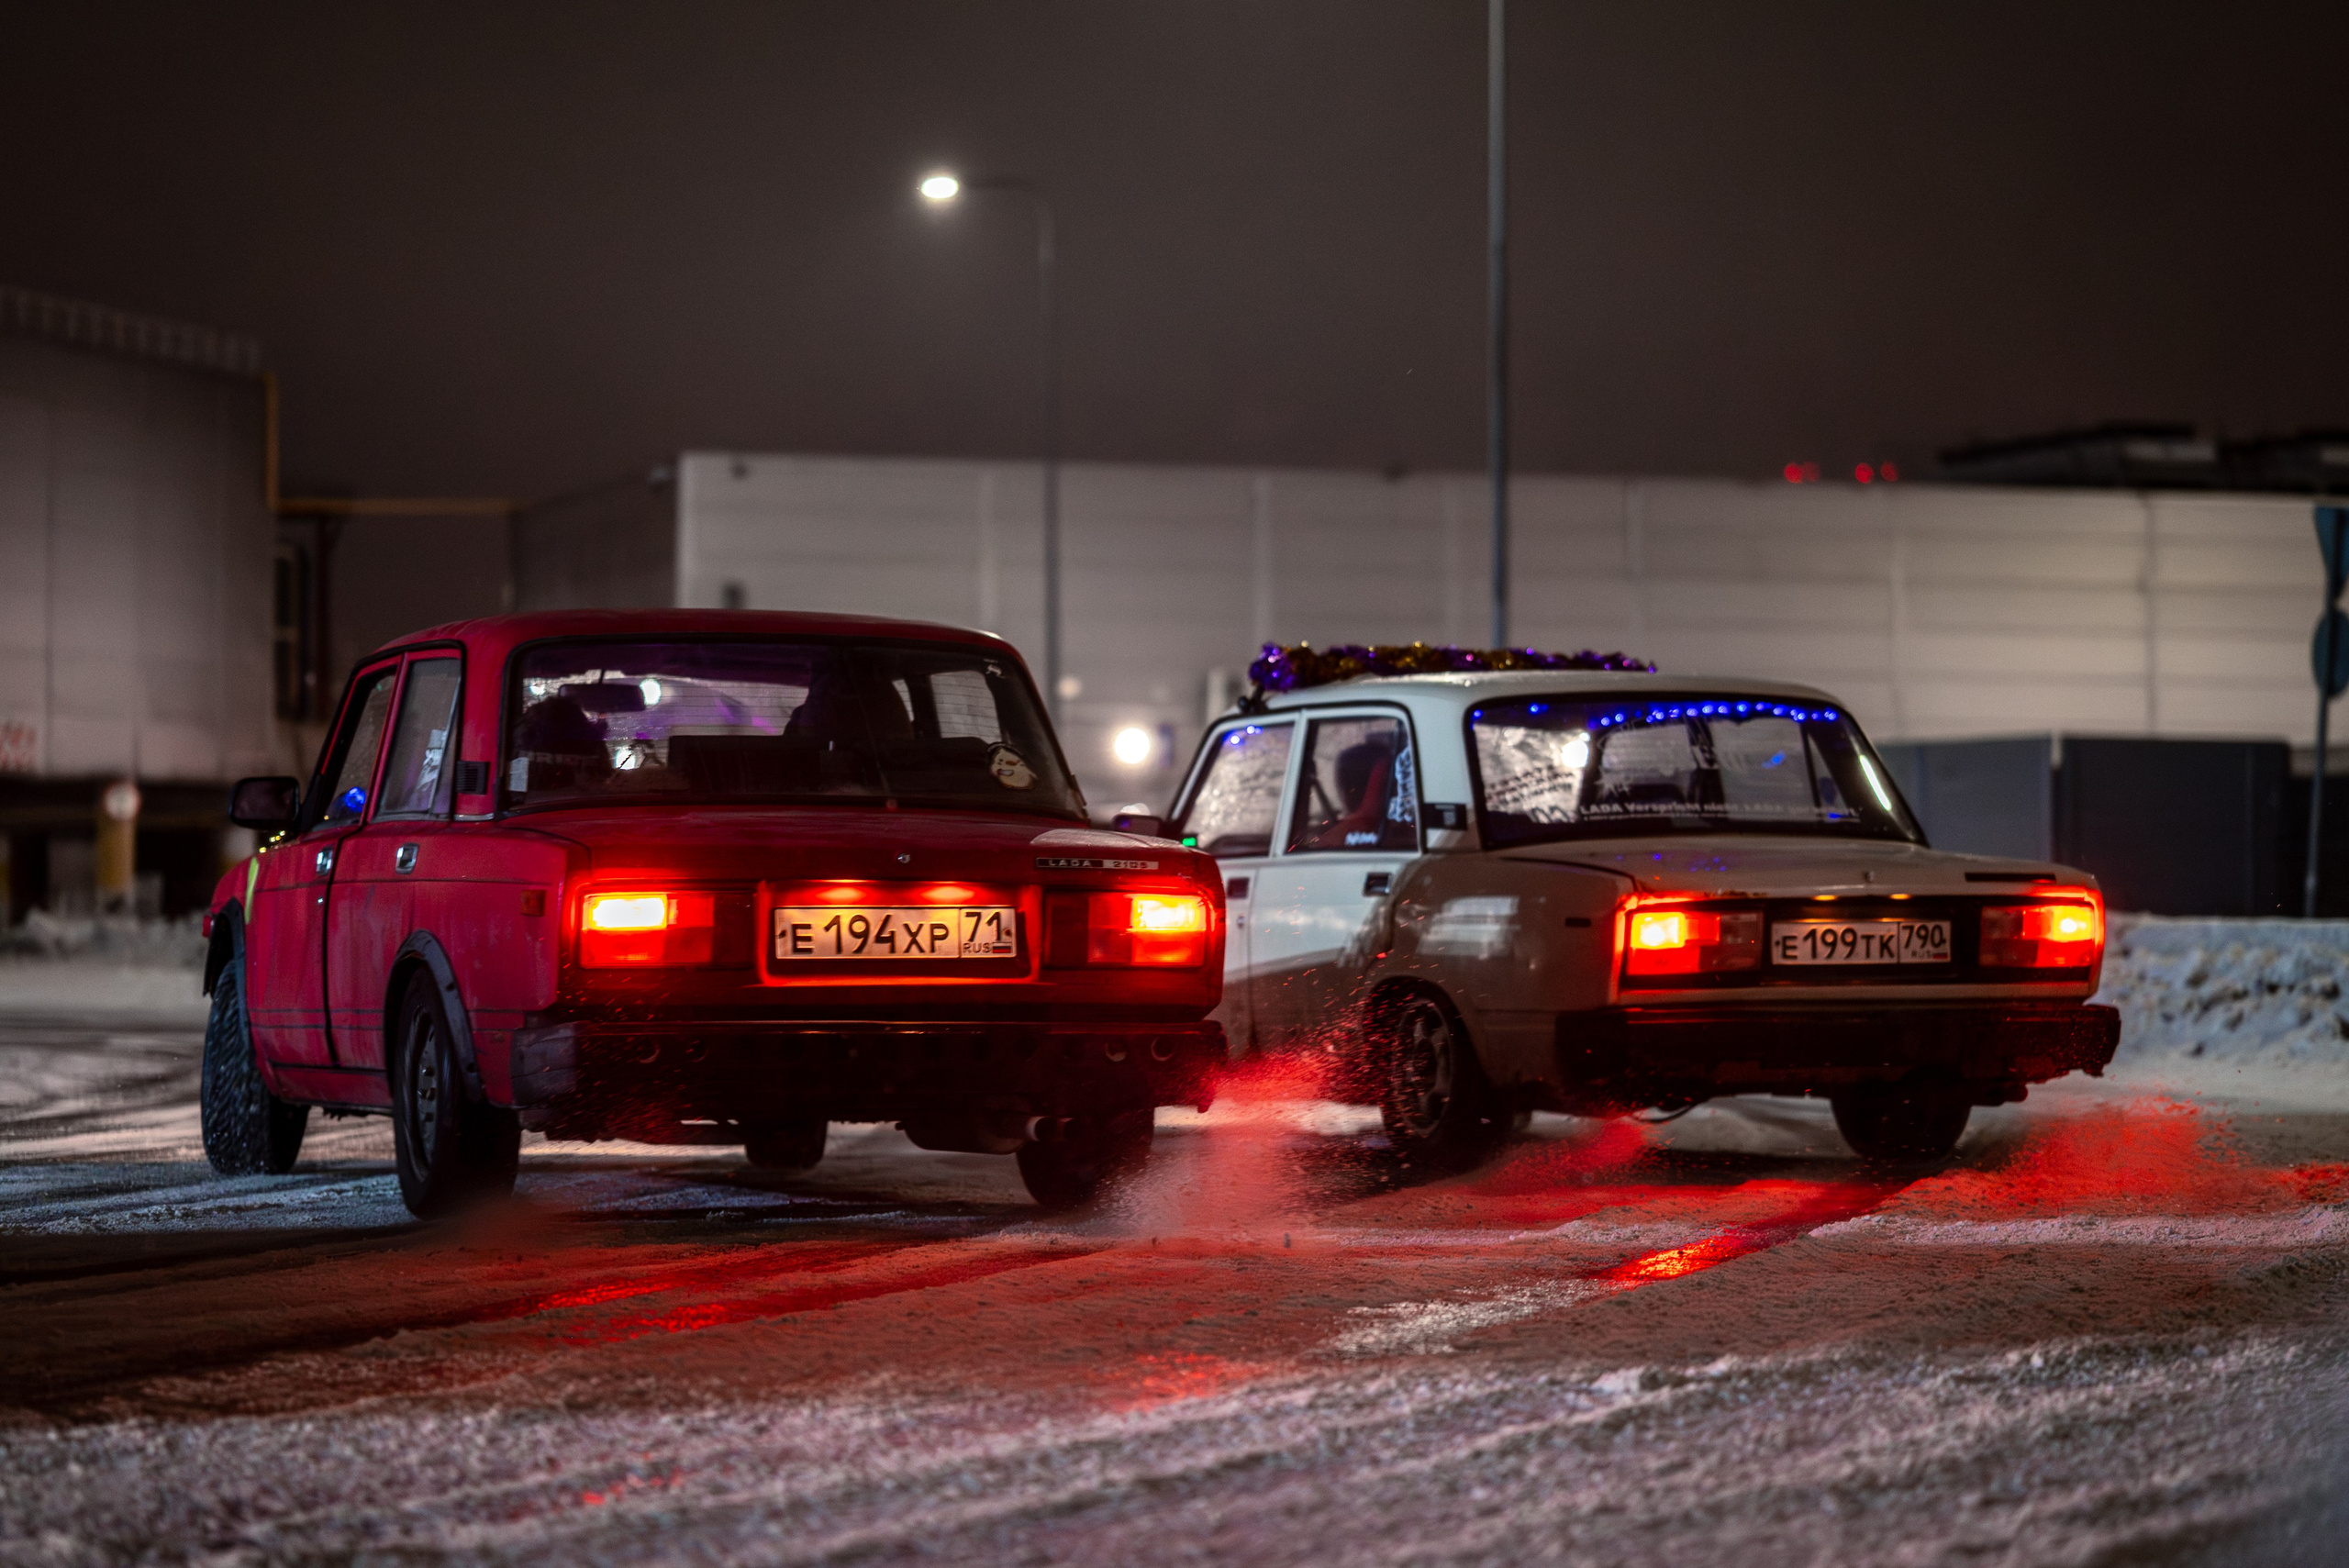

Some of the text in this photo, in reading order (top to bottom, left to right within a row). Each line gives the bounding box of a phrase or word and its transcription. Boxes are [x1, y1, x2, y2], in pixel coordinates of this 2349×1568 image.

[1048, 859, 1148, 869] LADA 2105
[792, 911, 1002, 954] Е194ХР 71
[1781, 924, 1944, 960] Е199ТК 790
[963, 942, 992, 953] RUS
